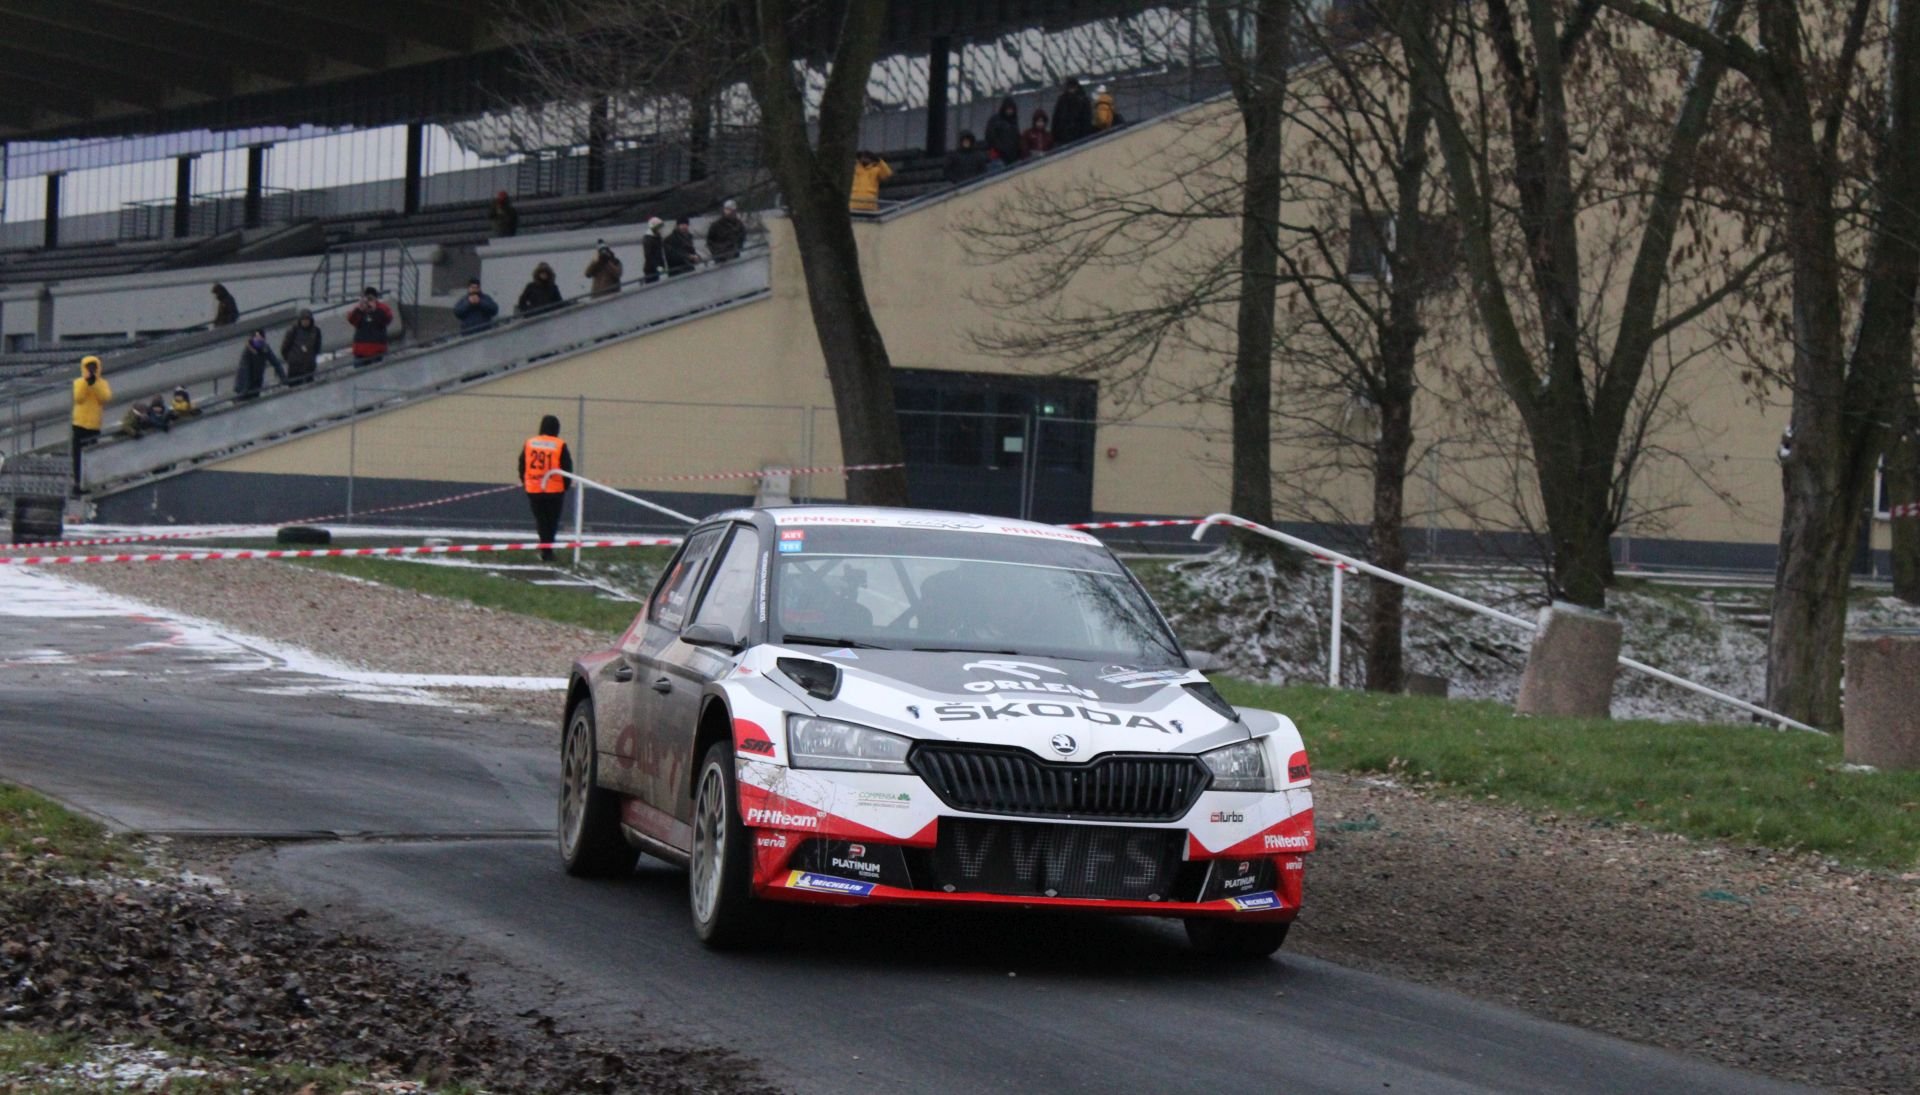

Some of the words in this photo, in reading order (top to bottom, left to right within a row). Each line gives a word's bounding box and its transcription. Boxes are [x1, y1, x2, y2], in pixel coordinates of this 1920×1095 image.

[530, 450, 552, 470] 291
[963, 679, 1099, 700] ORLEN
[934, 702, 1171, 734] ŠKODA
[858, 791, 896, 800] COMPENSA
[747, 808, 817, 828] PFNteam
[832, 858, 880, 873] PLATINUM
[811, 879, 864, 891] MICHELIN
[1224, 875, 1256, 889] PLATINUM
